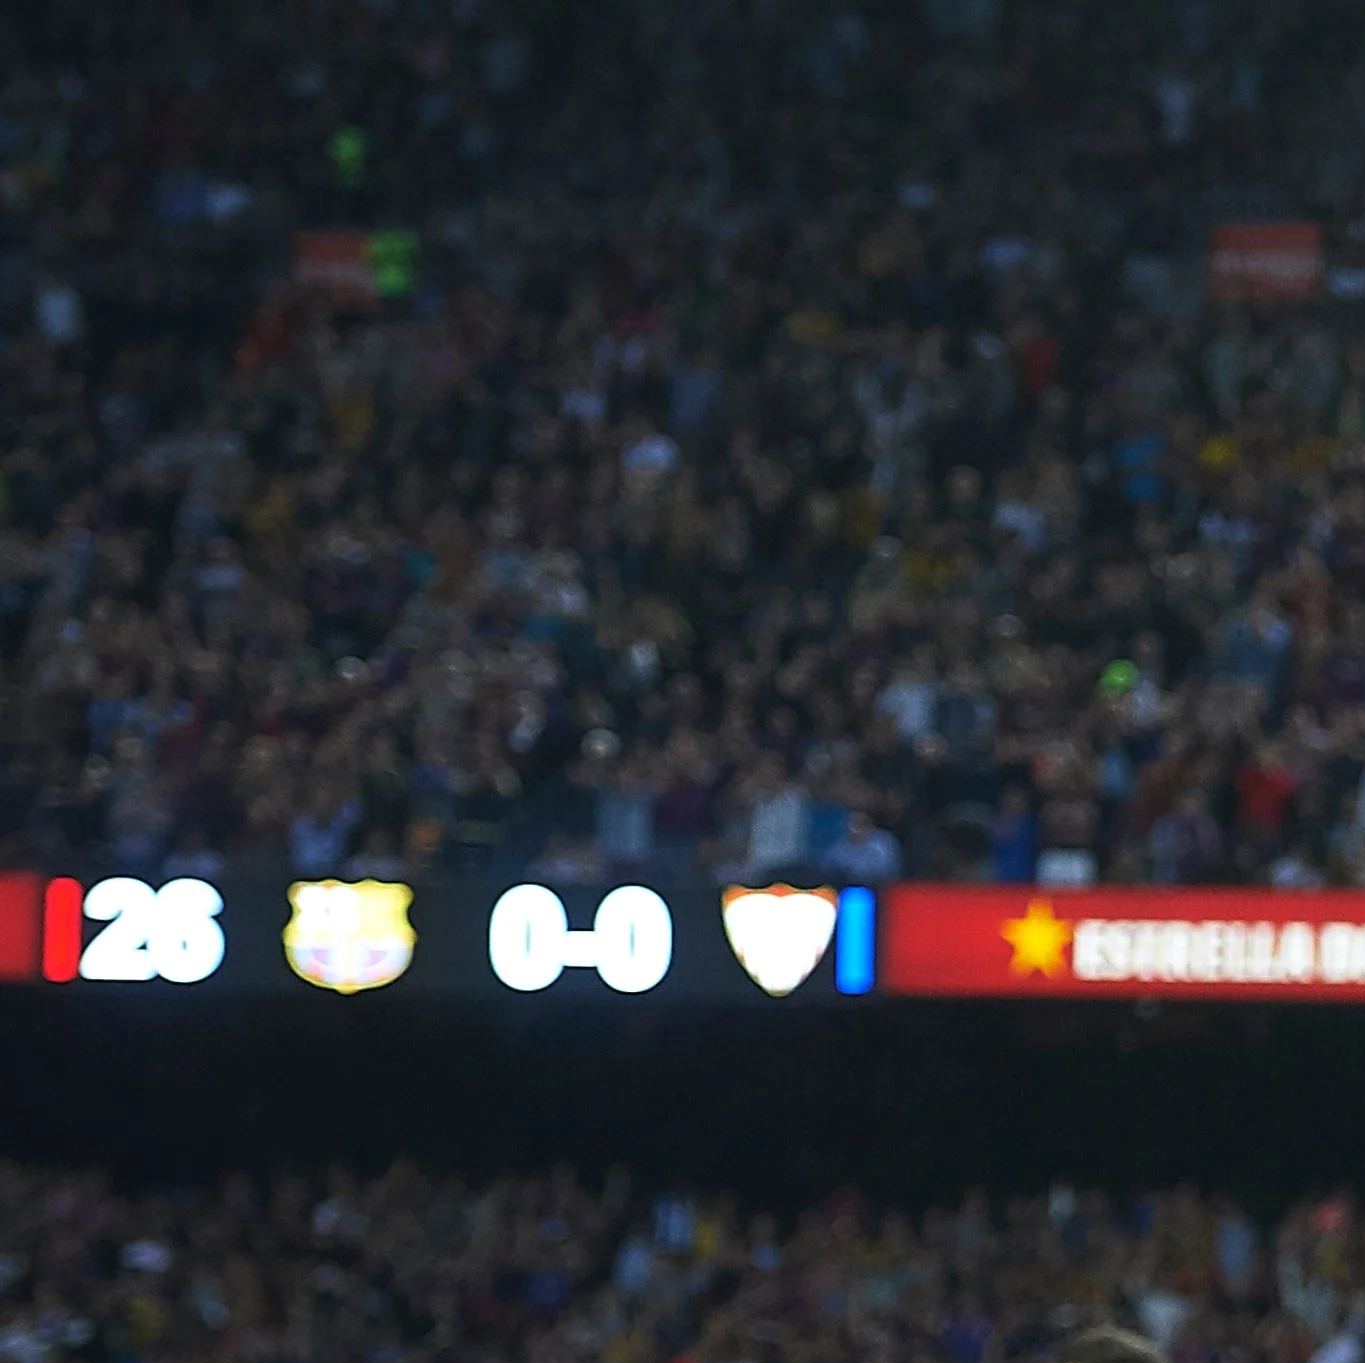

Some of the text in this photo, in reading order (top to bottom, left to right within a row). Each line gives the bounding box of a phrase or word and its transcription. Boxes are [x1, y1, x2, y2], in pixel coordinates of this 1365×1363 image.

[79, 876, 225, 984] 26
[489, 883, 674, 993] 0-0
[1073, 918, 1316, 984] ESTRELLA
